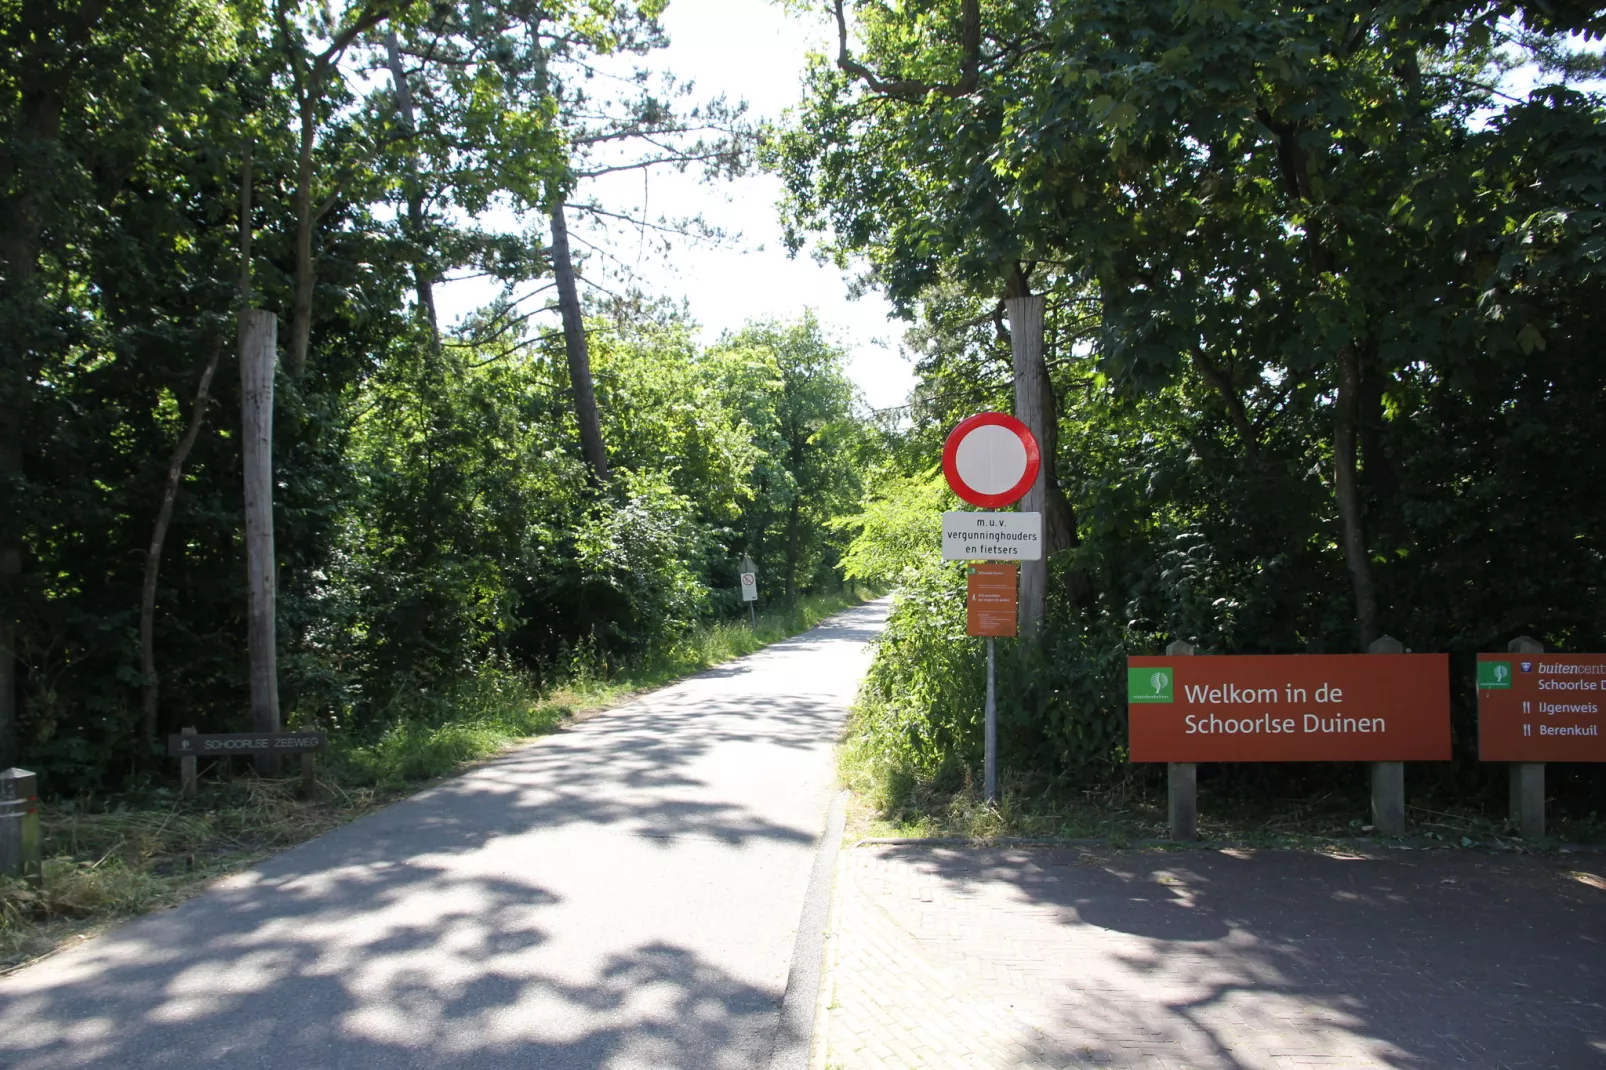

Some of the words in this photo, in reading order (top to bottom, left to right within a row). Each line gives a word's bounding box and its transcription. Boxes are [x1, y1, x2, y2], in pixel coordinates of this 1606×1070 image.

[947, 530, 1038, 542] vergunninghouders
[965, 545, 977, 554] en
[980, 544, 1018, 555] fietsers
[1538, 662, 1606, 674] buitencent
[1538, 679, 1598, 690] Schoorlse
[1184, 683, 1278, 704] Welkom
[1285, 683, 1307, 703] in
[1314, 682, 1343, 703] de
[1184, 713, 1296, 734] Schoorlse
[1303, 713, 1386, 733] Duinen
[1540, 724, 1598, 736] Berenkuil
[204, 739, 269, 749] SCHOORLSE
[274, 737, 319, 748] ZEEWEG
